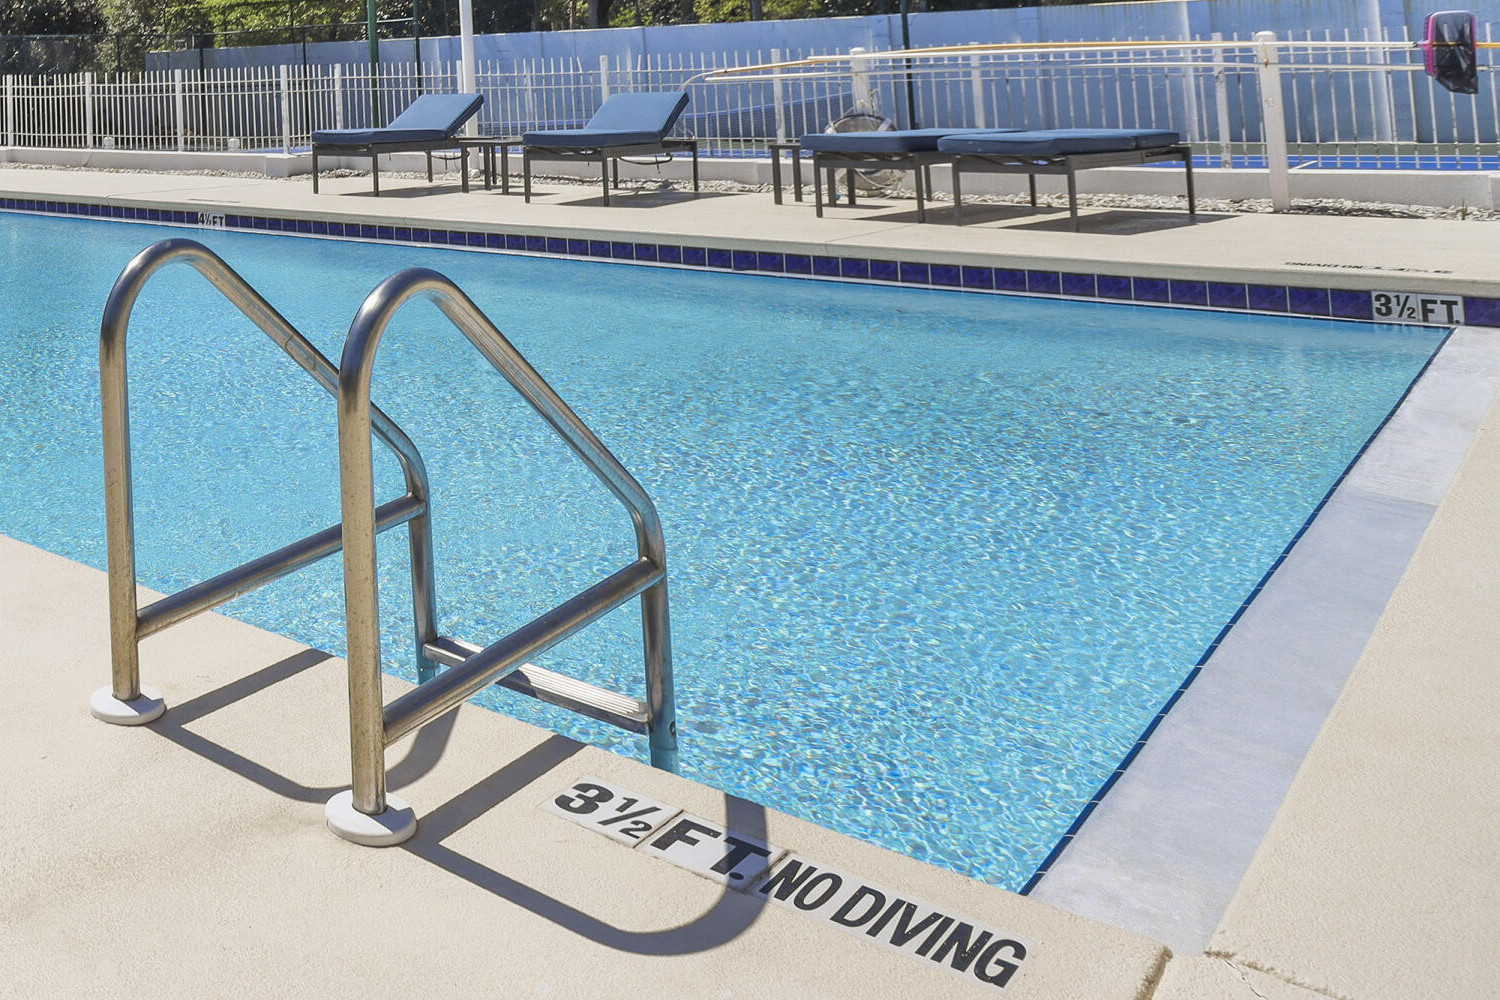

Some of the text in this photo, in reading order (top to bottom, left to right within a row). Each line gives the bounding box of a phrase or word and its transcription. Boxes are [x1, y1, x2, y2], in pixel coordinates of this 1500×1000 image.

[212, 215, 224, 227] FT
[1420, 299, 1460, 325] FT.
[650, 818, 772, 881] FT.
[758, 859, 843, 911] NO
[829, 884, 1027, 989] DIVING
